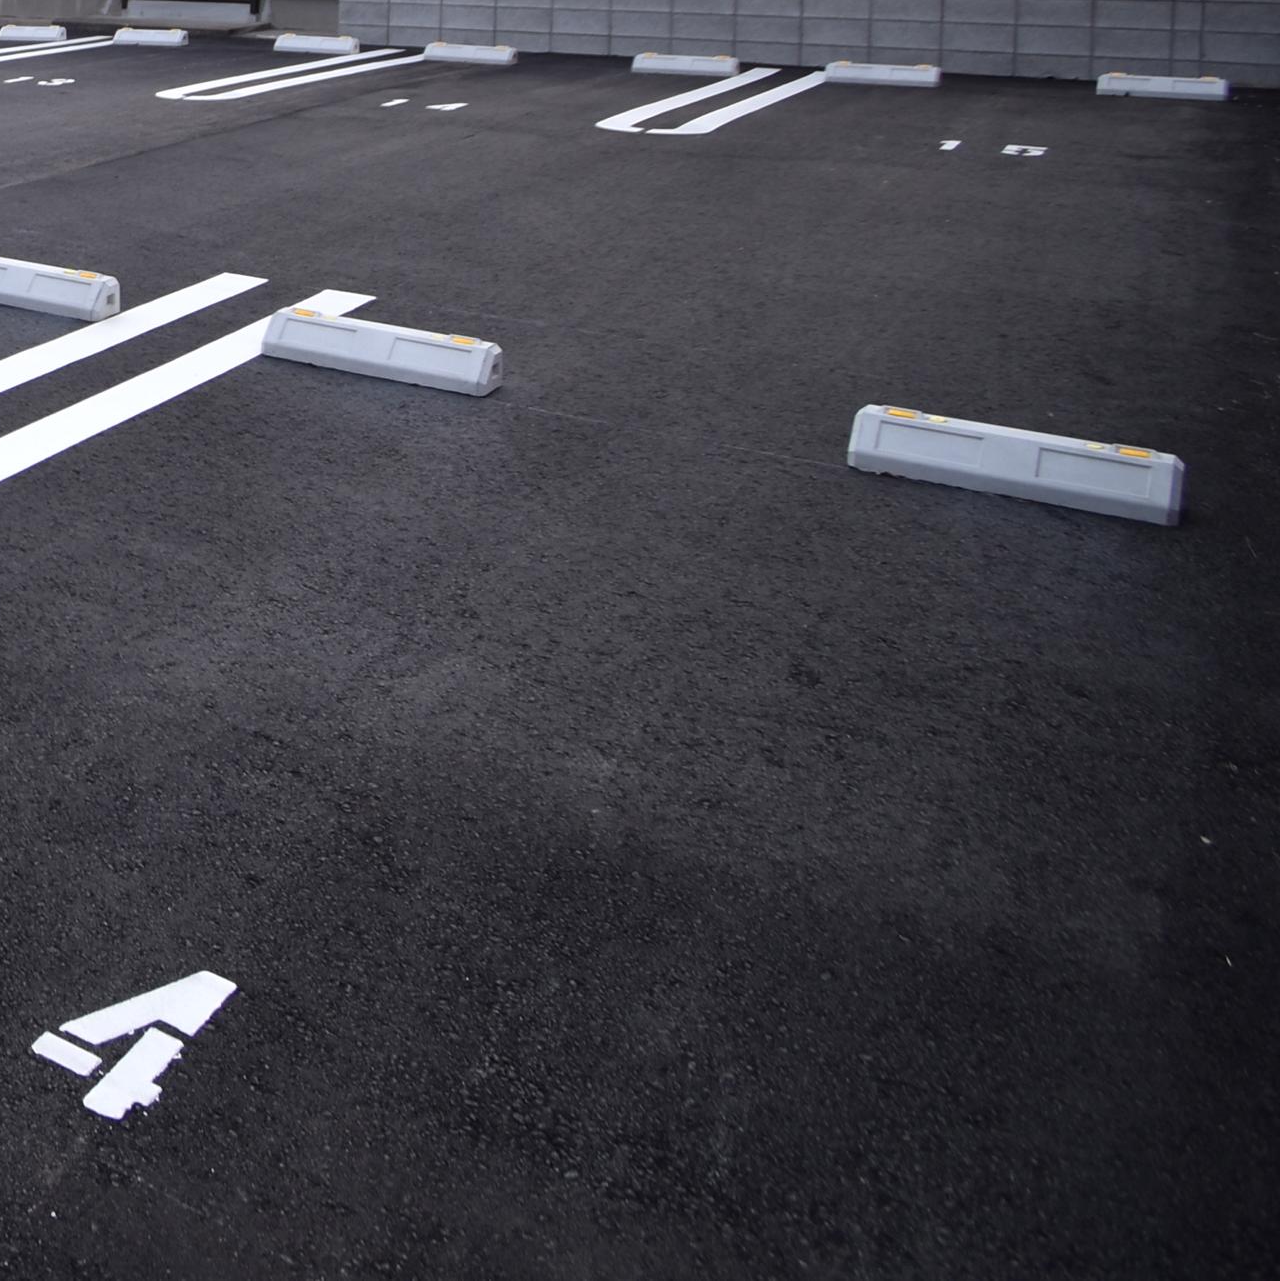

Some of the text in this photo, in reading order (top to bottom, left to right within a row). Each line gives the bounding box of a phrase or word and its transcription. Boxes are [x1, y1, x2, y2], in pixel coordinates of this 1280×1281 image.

[380, 98, 470, 111] 14
[939, 140, 1049, 156] 15
[31, 970, 237, 1120] 4
